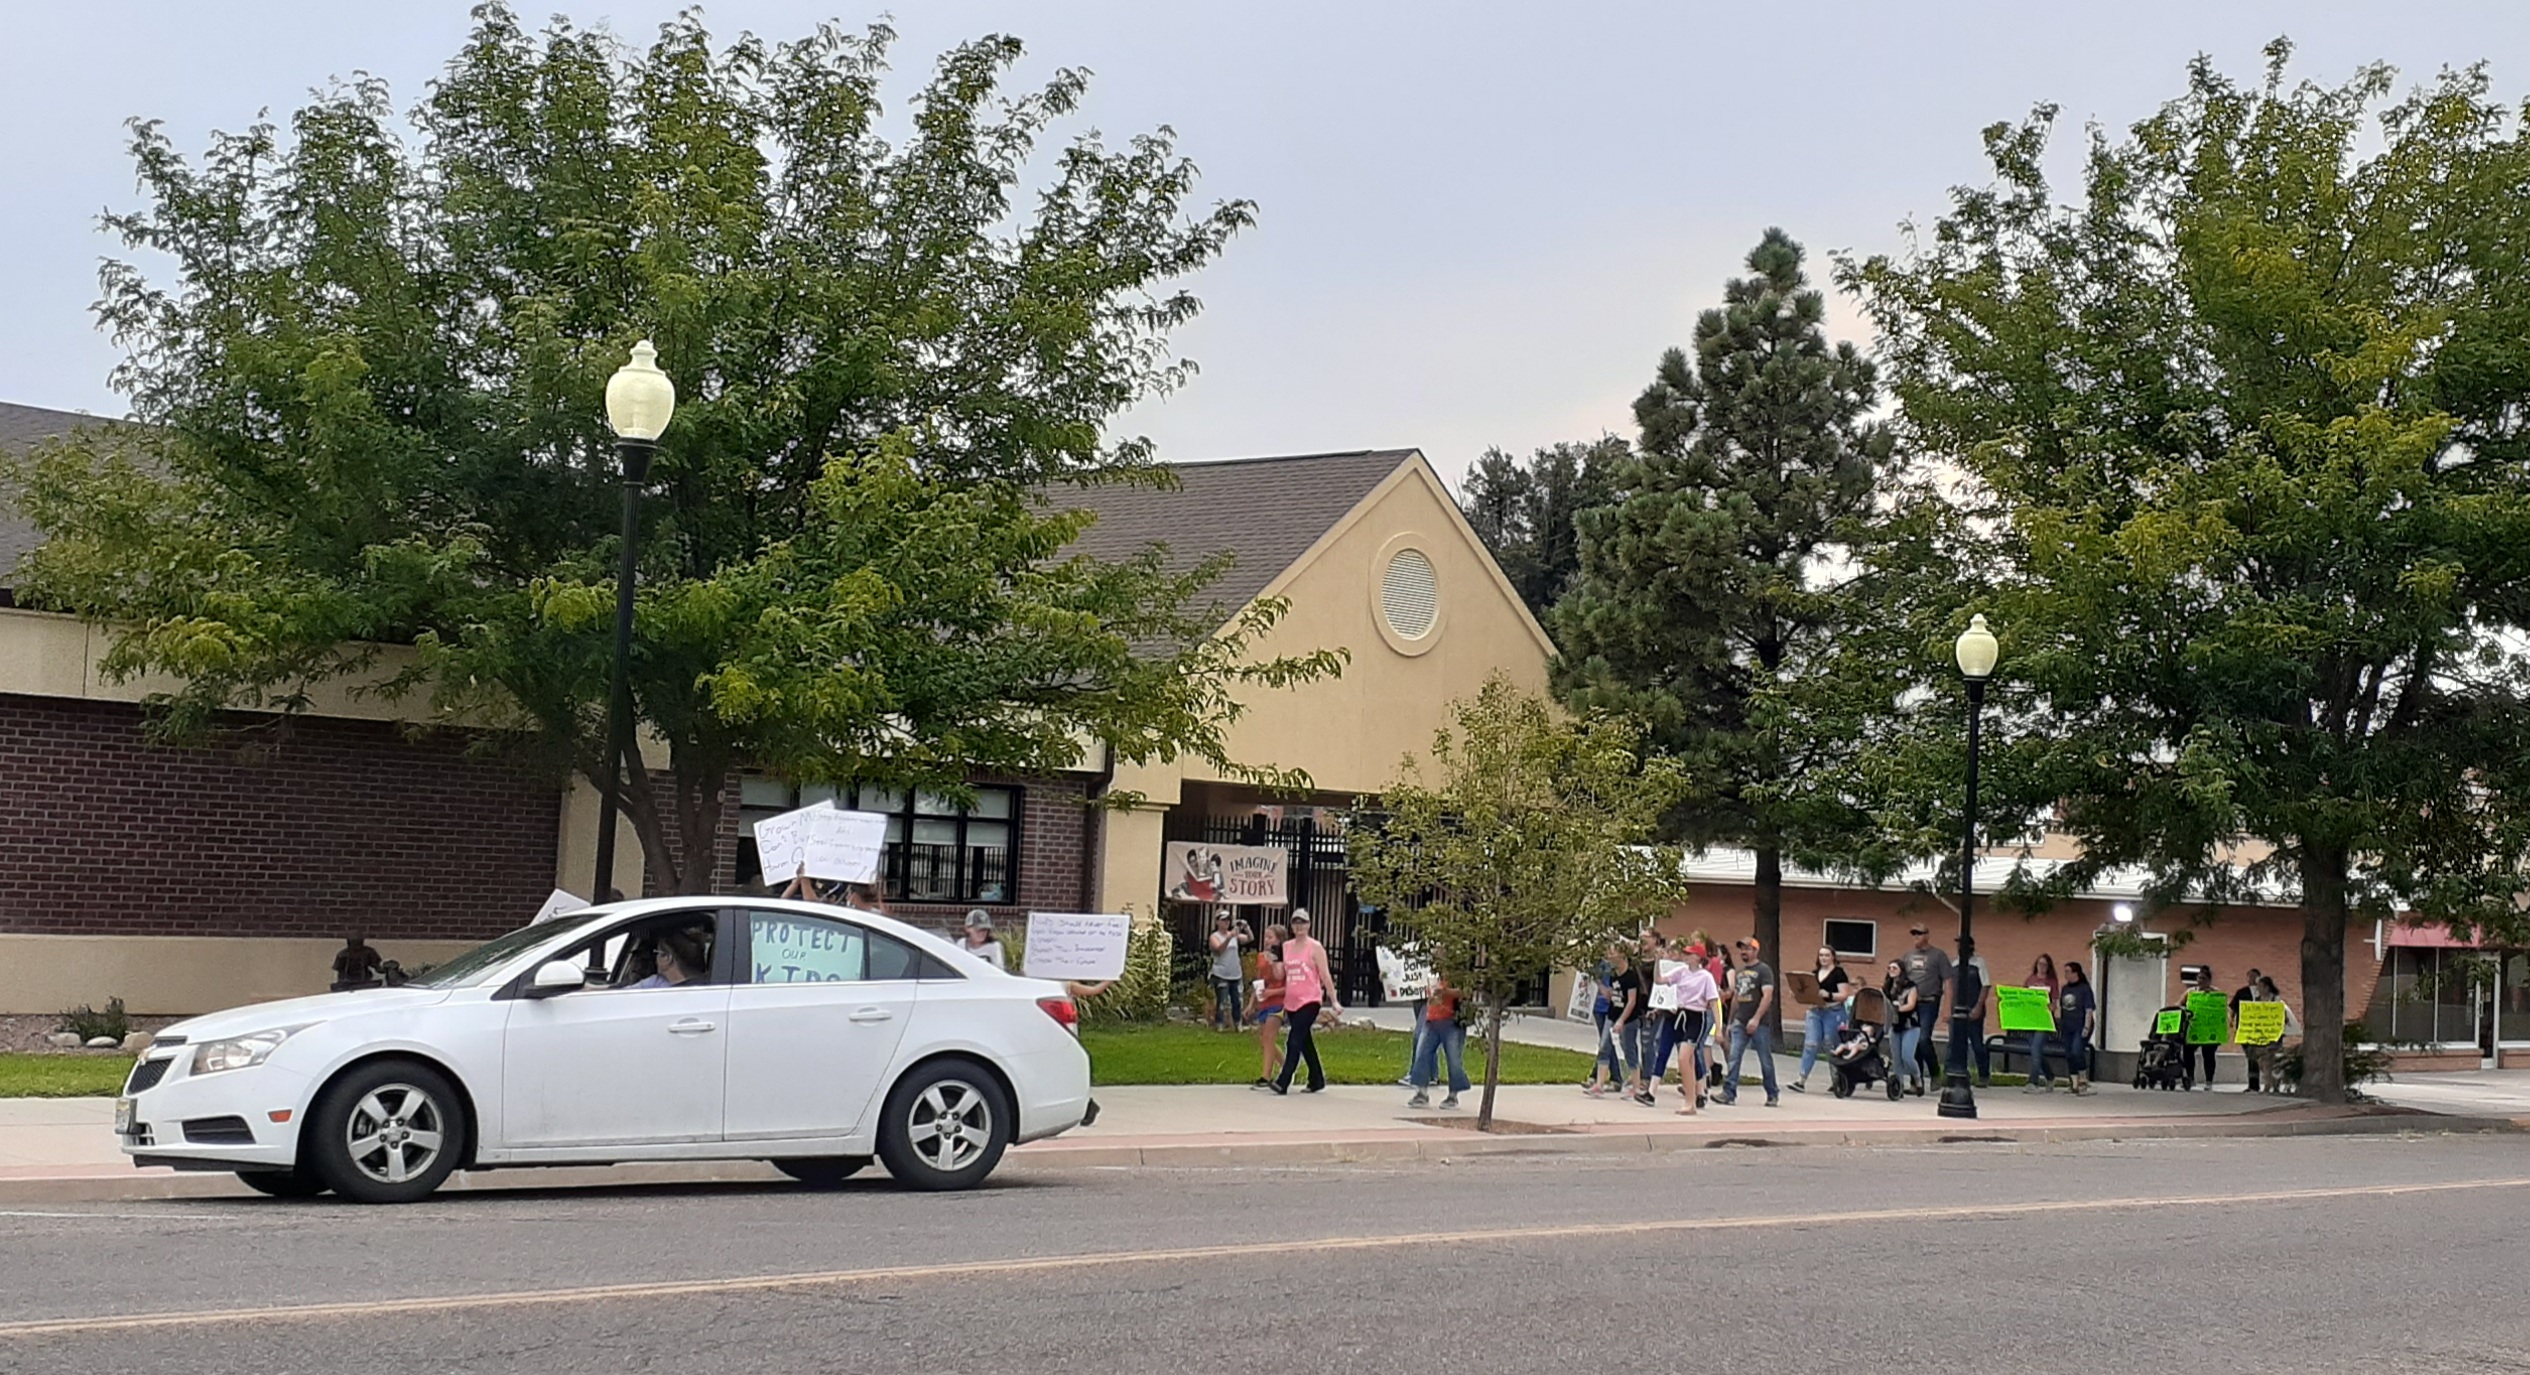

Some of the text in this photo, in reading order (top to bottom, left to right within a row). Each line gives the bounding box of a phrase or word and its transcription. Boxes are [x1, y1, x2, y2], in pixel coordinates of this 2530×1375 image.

[1230, 857, 1278, 873] IMAGINE
[1229, 878, 1276, 896] STORY
[752, 920, 859, 953] PROTECT
